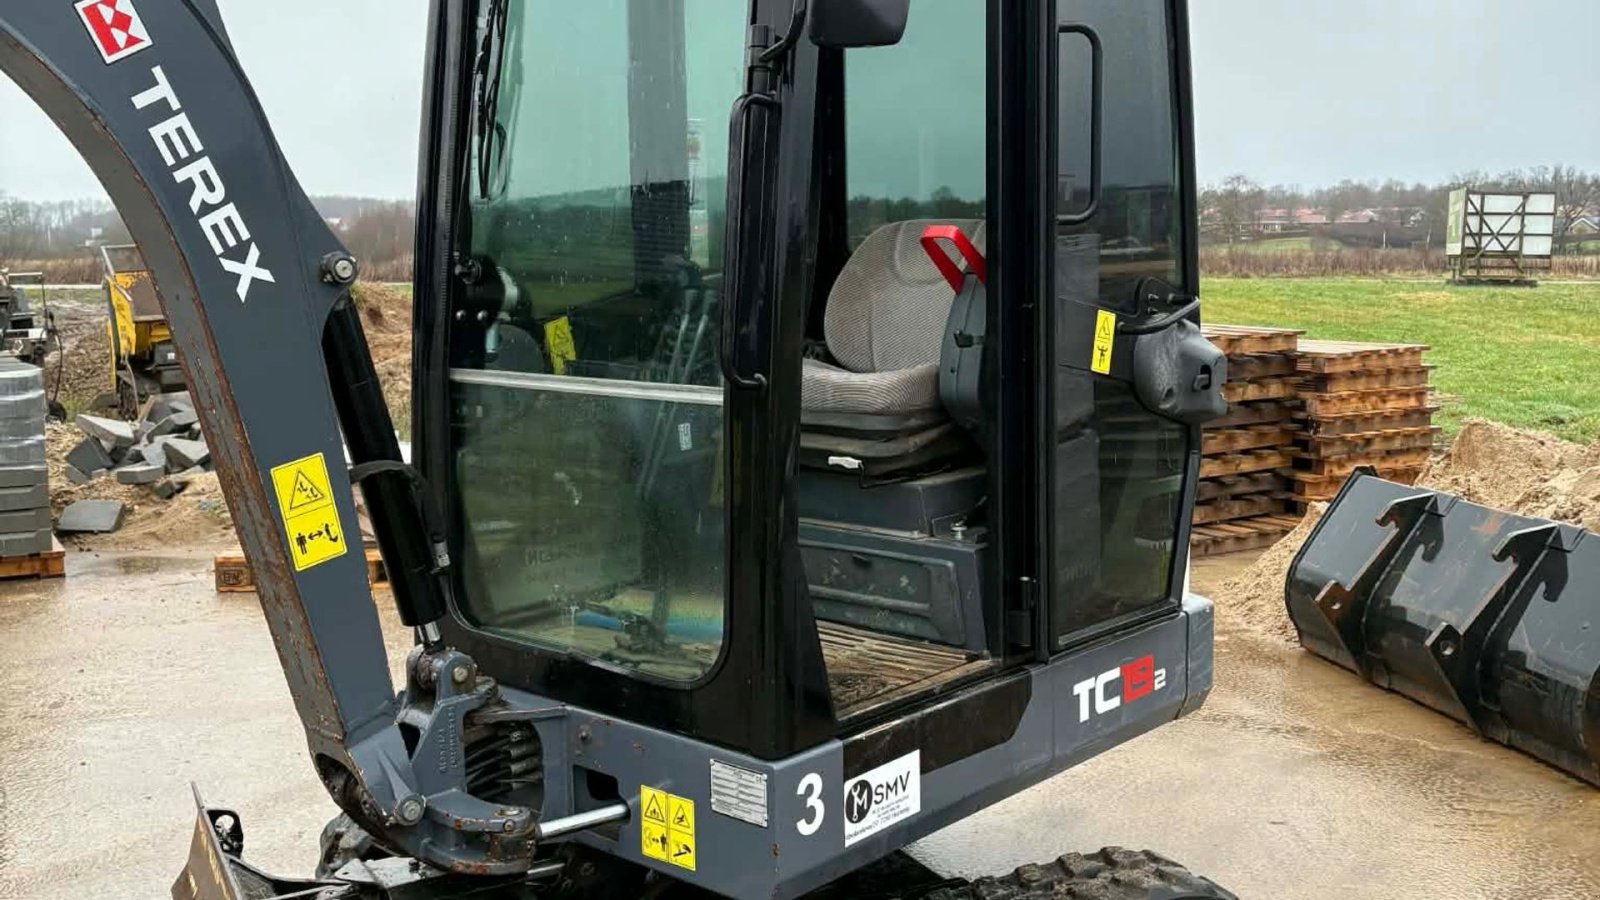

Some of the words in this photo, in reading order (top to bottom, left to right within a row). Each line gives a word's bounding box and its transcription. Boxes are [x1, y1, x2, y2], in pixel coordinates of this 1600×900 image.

[131, 65, 275, 303] TEREX
[796, 772, 825, 836] 3
[874, 770, 910, 805] SMV
